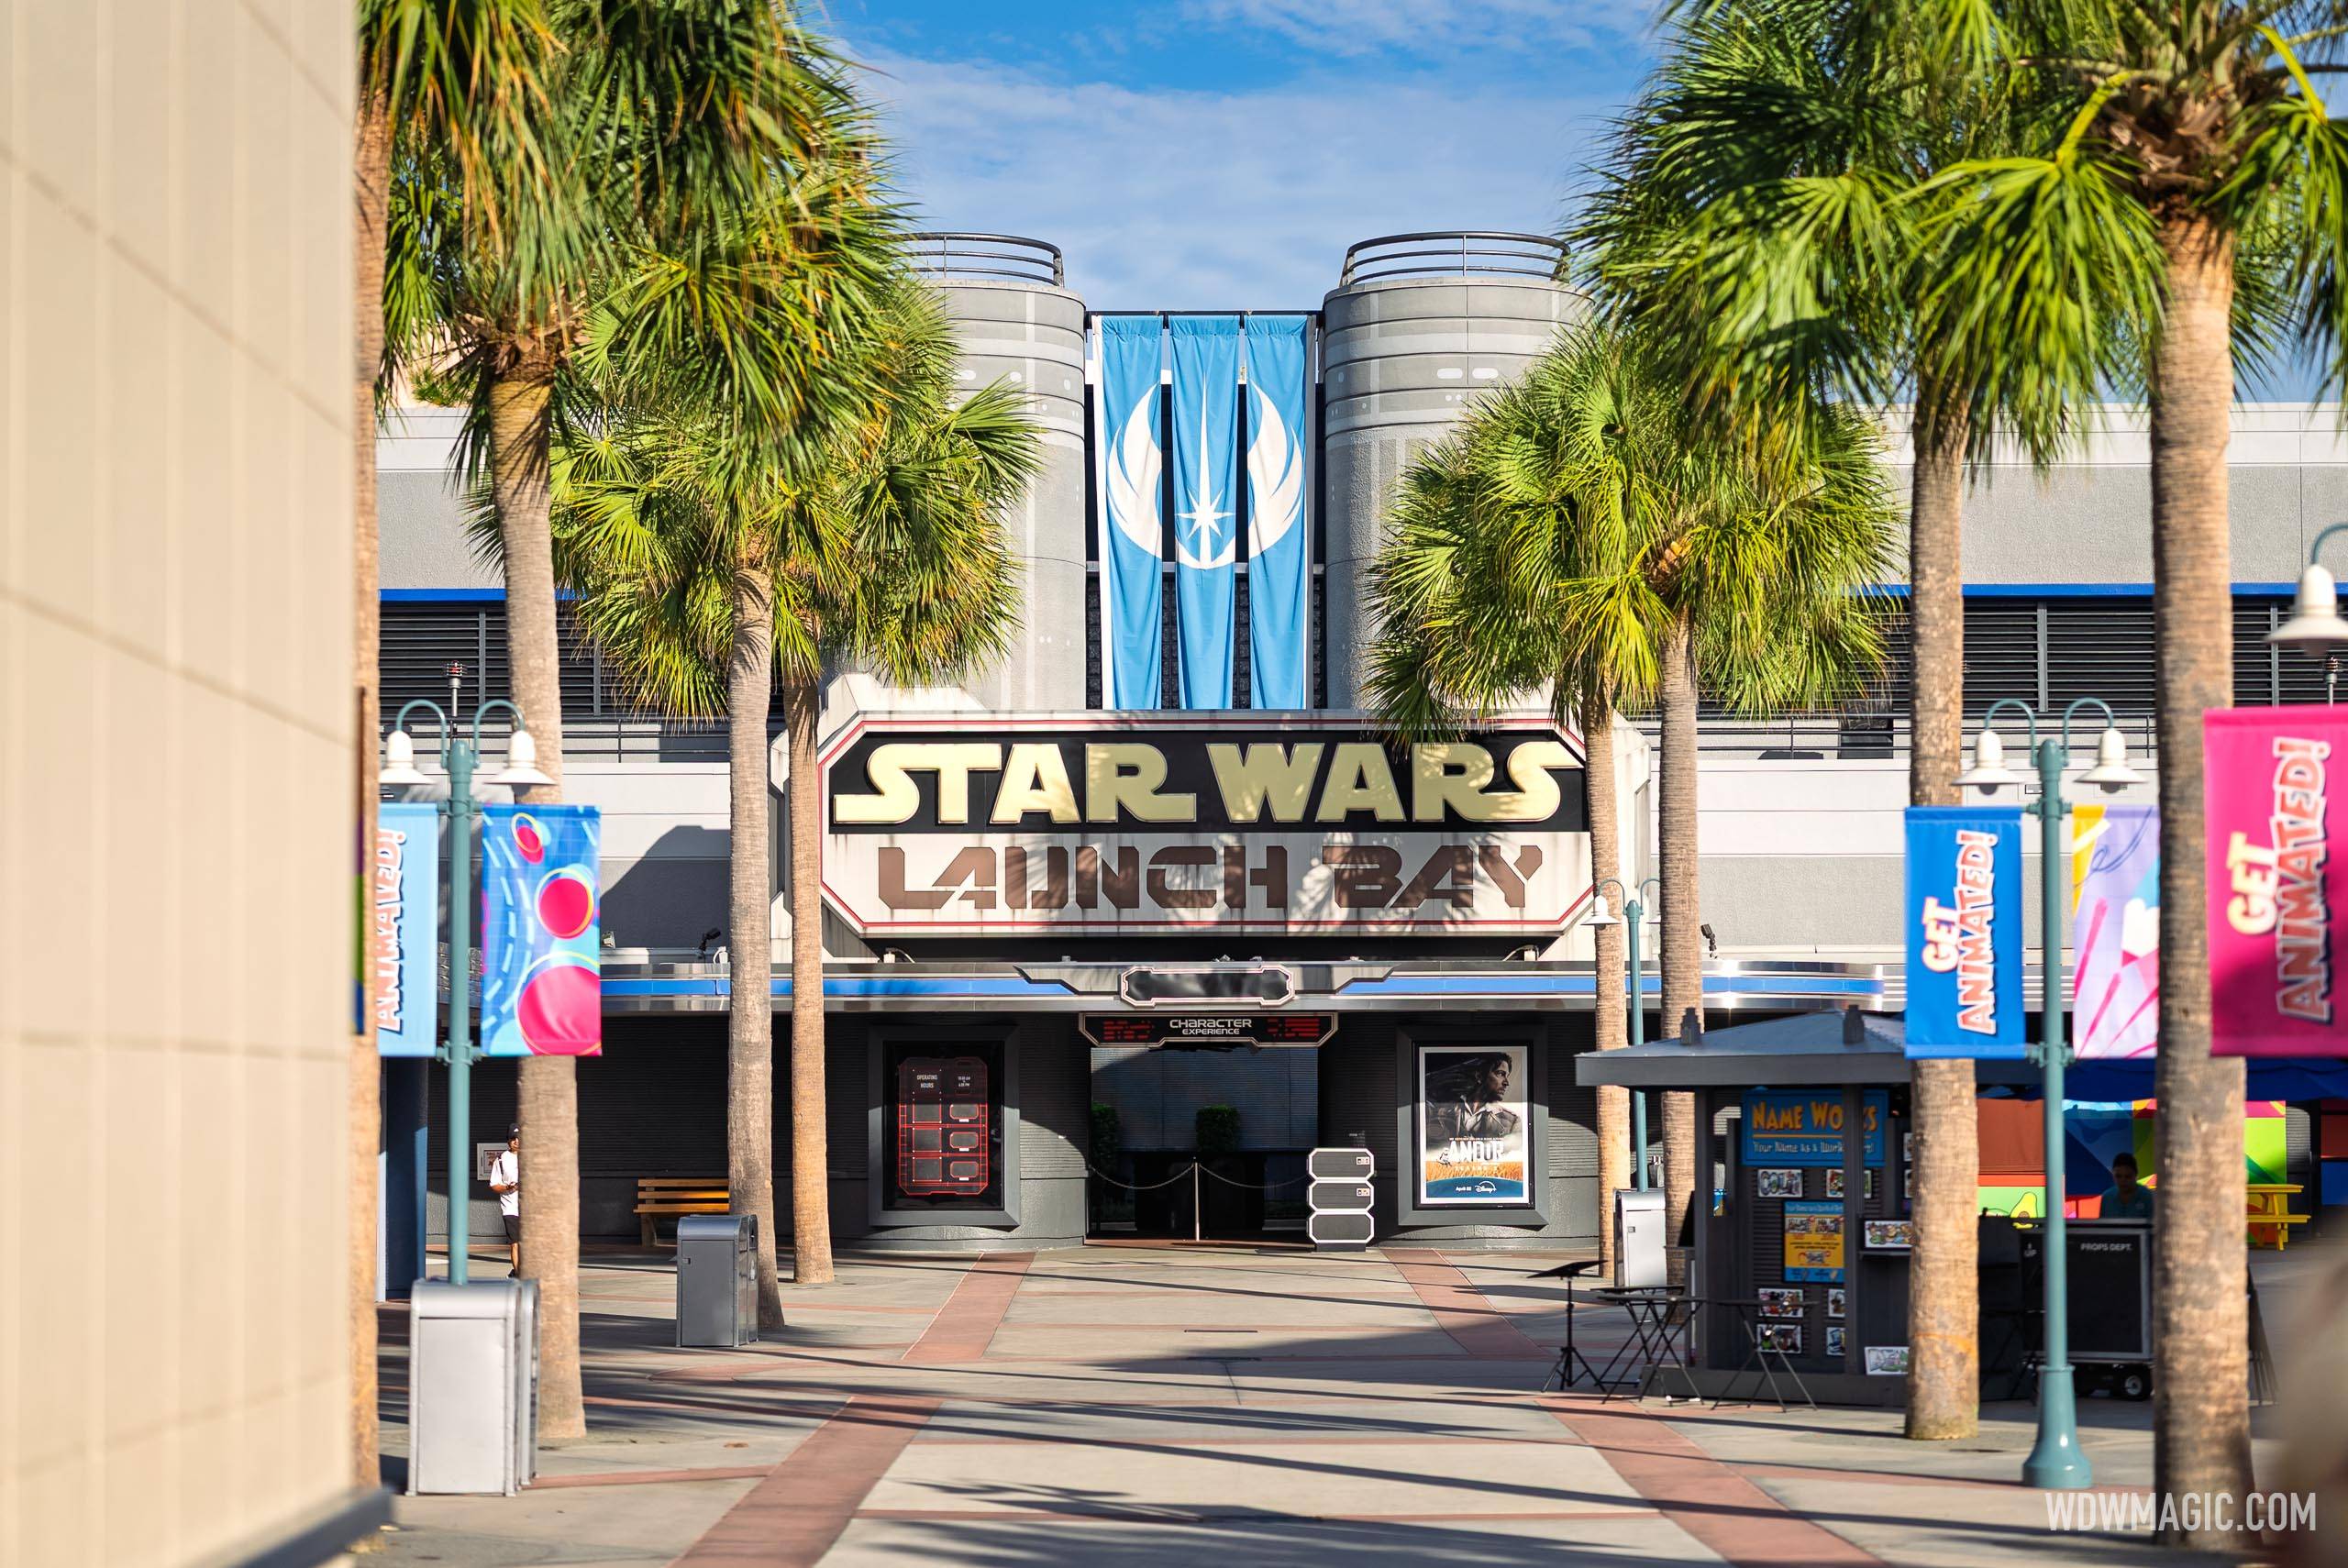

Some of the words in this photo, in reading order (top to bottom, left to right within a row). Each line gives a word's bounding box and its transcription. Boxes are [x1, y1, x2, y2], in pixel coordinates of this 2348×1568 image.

[833, 742, 1197, 823] STAR
[1205, 741, 1586, 823] WARS
[878, 846, 1286, 909] LAUNCH
[1322, 845, 1544, 909] BAY
[2226, 832, 2277, 934] GET
[2270, 737, 2331, 1024] ANIMATED!
[1922, 896, 1959, 973] GET
[1955, 830, 1998, 1035] ANIMATED!
[1169, 1019, 1253, 1028] CHARACTER
